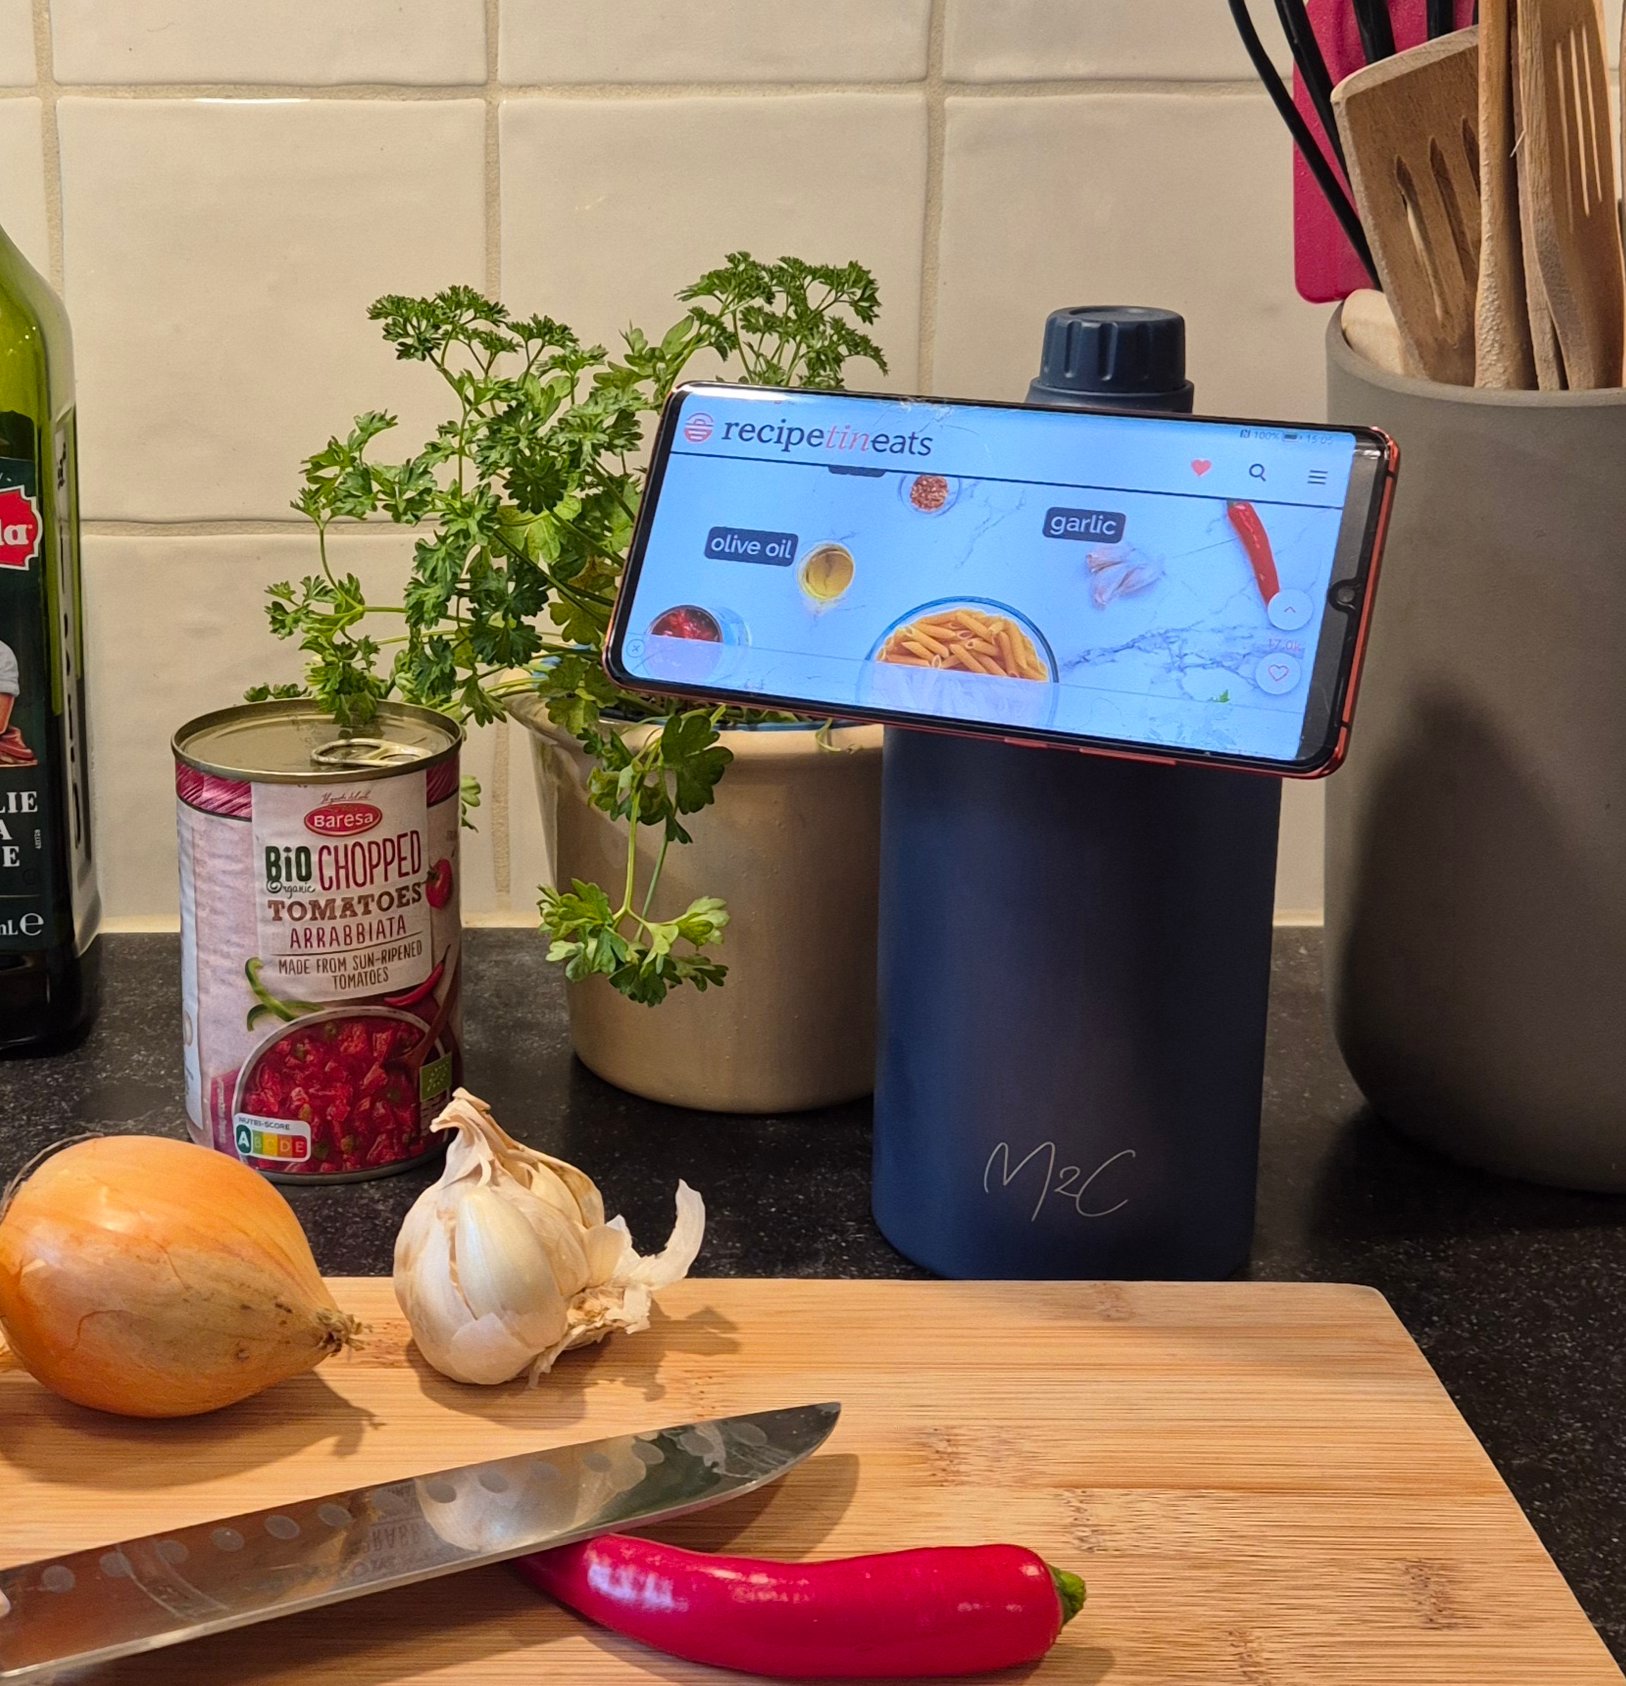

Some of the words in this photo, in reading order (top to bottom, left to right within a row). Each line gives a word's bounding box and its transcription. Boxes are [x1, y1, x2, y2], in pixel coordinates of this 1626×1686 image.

[721, 417, 932, 457] recipetineats
[1254, 431, 1279, 441] 100%
[0, 518, 29, 546] a
[1049, 512, 1117, 538] garlic
[710, 533, 762, 556] olive
[764, 538, 793, 561] oil
[314, 812, 374, 829] Baresa
[317, 829, 422, 892] CHOPPED
[265, 879, 316, 899] Organic
[267, 882, 423, 922] TOMATOES
[290, 914, 407, 950] ARRABBIATA
[278, 959, 310, 975] MADE
[316, 956, 347, 973] FROM
[352, 939, 423, 971] SUN-RIPENED
[331, 966, 390, 991] TOMATOES
[238, 1116, 290, 1131] NUTRI-SCORE
[238, 1131, 249, 1147] A
[280, 1140, 290, 1152] D
[295, 1141, 305, 1153] E
[983, 1140, 1137, 1223] M2C
